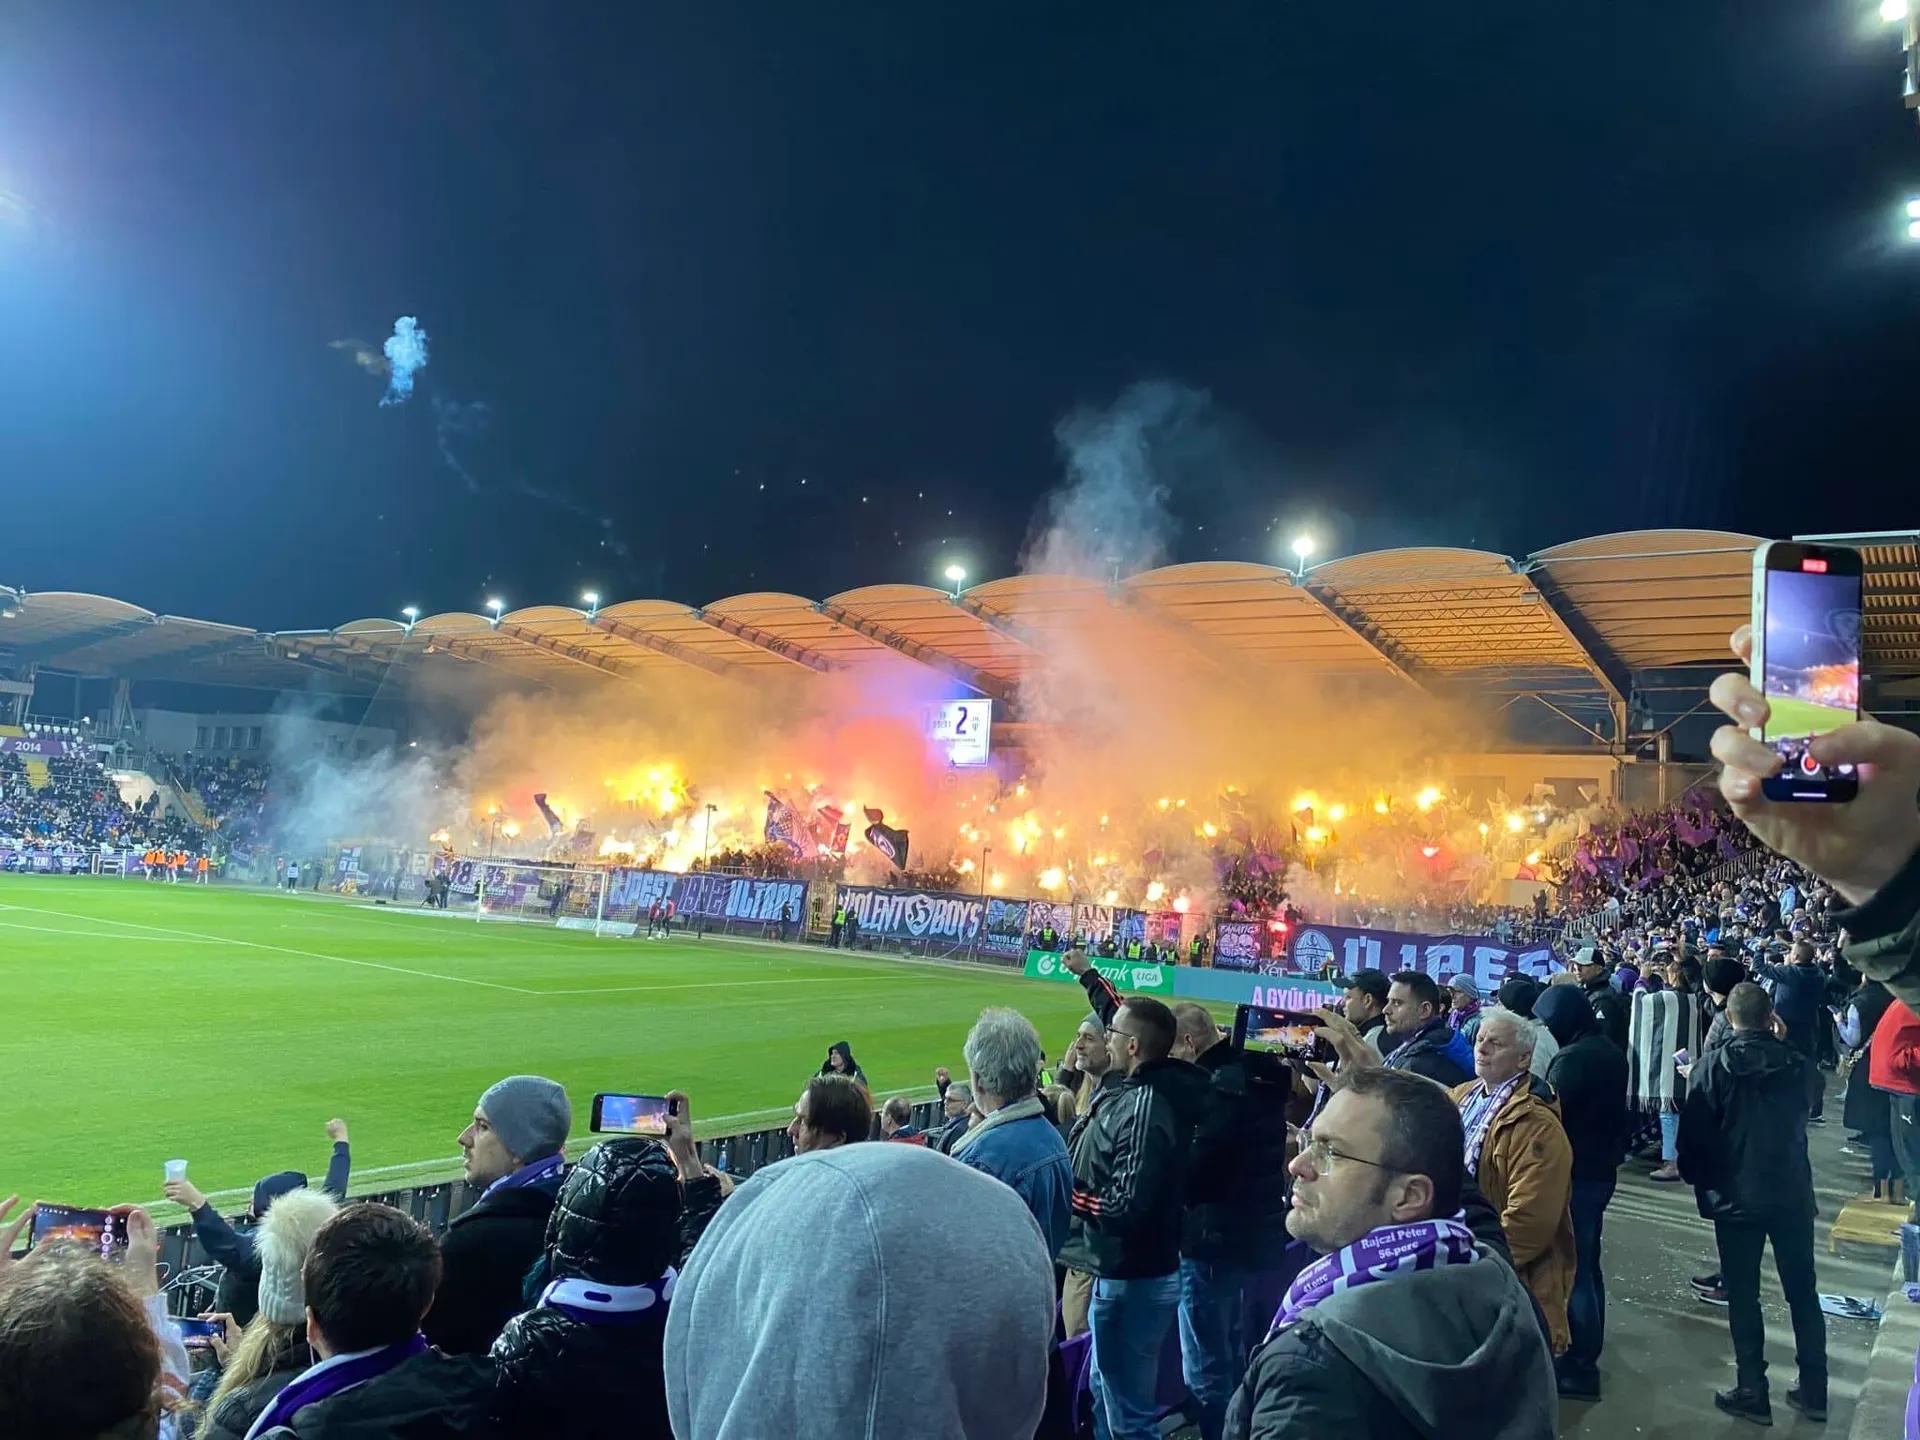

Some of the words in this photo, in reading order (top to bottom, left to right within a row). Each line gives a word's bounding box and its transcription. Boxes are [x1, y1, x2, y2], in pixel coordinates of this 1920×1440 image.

[955, 706, 968, 734] 2
[15, 741, 41, 752] 2014
[929, 898, 983, 943] BOYS
[1136, 970, 1158, 983] LIGA
[1252, 985, 1263, 1006] A
[1397, 1227, 1428, 1241] Péter
